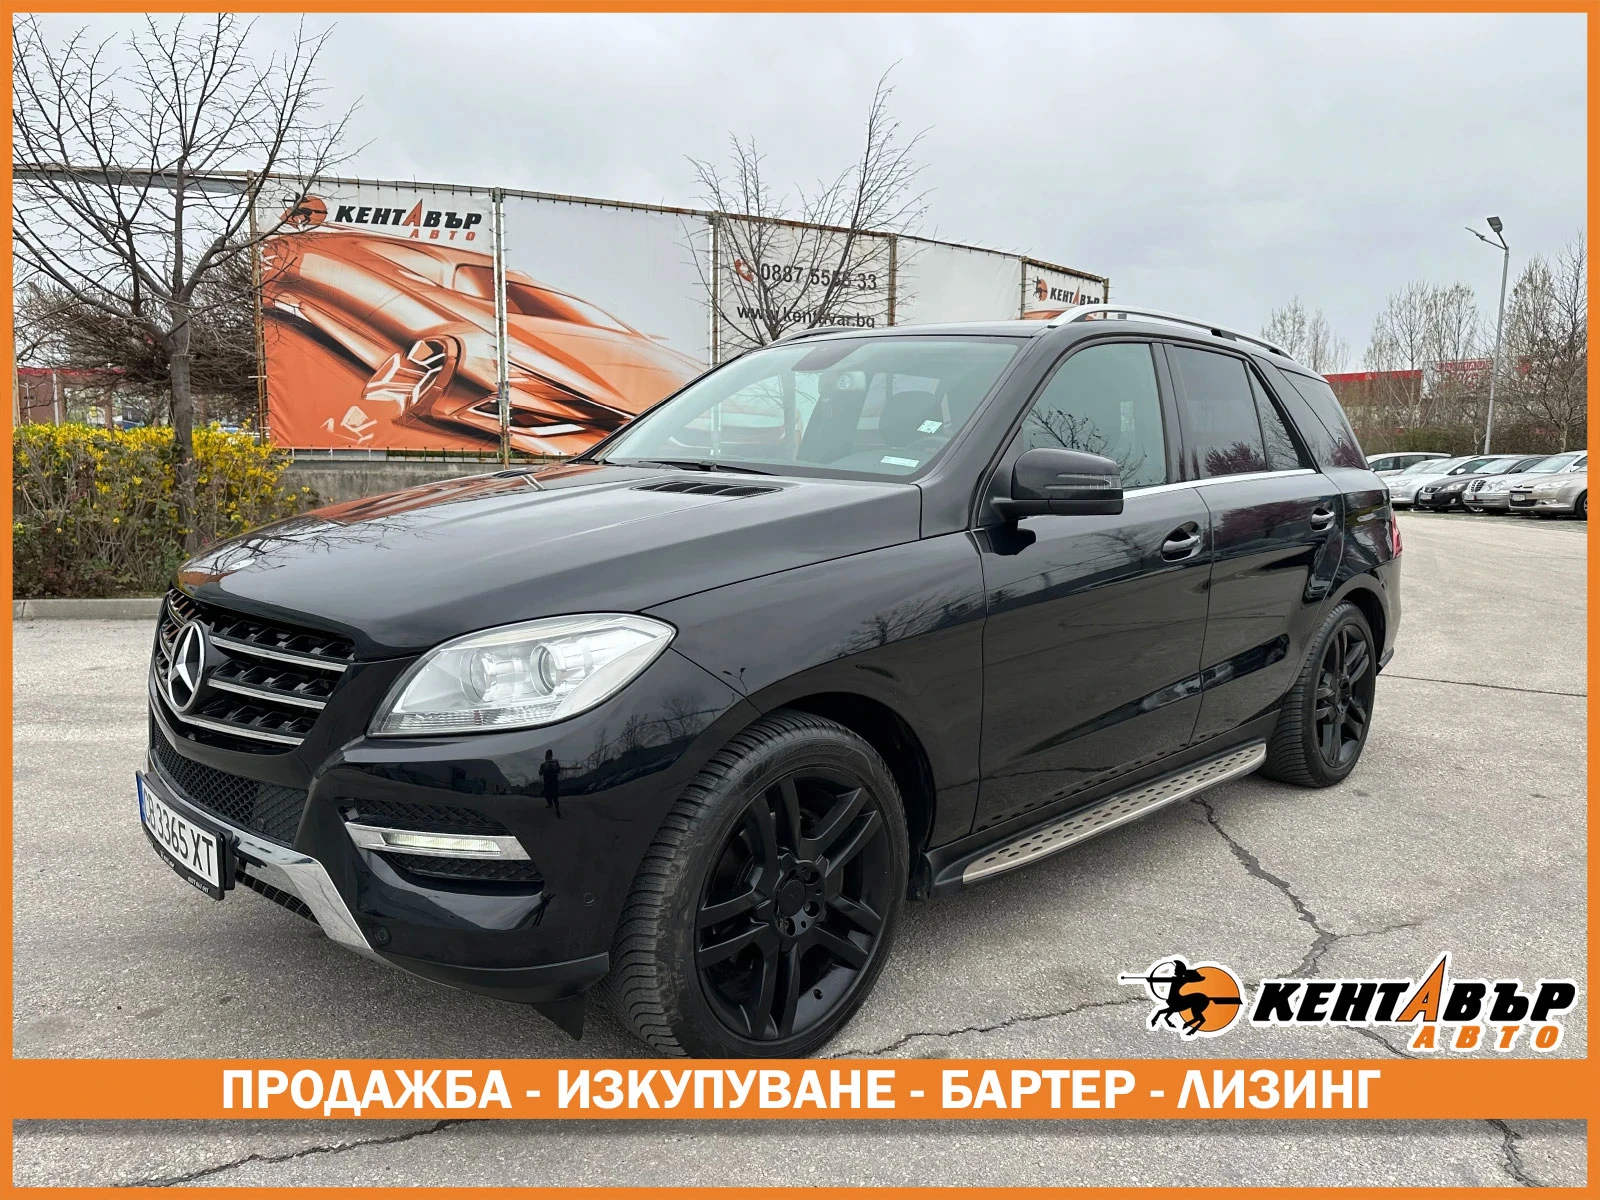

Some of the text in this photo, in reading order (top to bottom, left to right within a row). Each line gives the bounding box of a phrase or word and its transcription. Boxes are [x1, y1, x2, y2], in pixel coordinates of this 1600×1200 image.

[335, 199, 482, 229] КЕНТАВЪР
[409, 228, 476, 241] АВТО
[761, 263, 803, 282] 0887
[857, 273, 877, 290] 33
[737, 307, 875, 328] wwwkenavar.bg
[157, 803, 188, 860] 3365
[190, 829, 213, 876] XT
